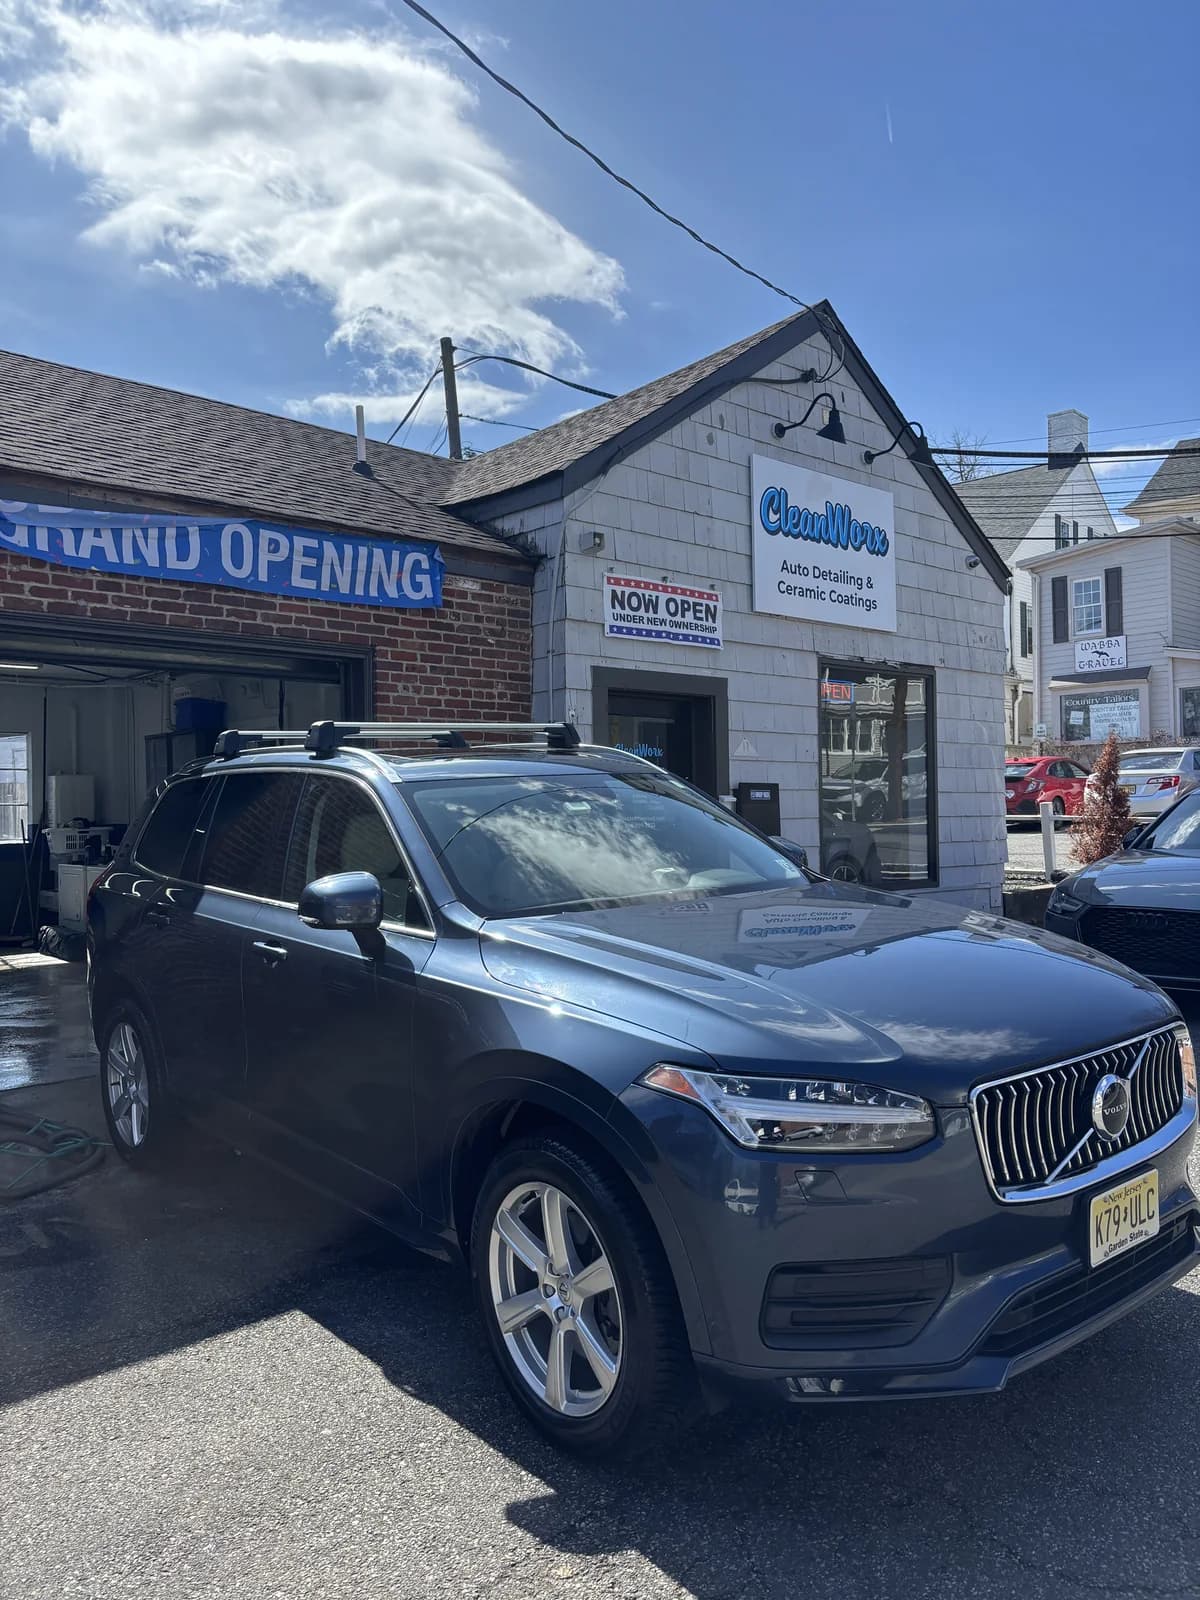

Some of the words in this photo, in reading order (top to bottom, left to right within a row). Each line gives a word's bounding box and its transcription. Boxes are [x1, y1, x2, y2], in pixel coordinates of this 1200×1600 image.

[760, 486, 889, 557] CleanWorx
[220, 523, 433, 600] OPENING
[780, 559, 810, 577] Auto
[812, 565, 863, 590] Detailing
[866, 576, 874, 590] &
[610, 589, 659, 615] NOW
[665, 597, 718, 624] OPEN
[777, 580, 827, 601] Ceramic
[829, 589, 878, 612] Coatings
[612, 612, 645, 625] UNDER
[646, 616, 667, 627] NEW
[668, 619, 717, 634] OWNERSHIP
[1080, 639, 1121, 652] WABBA
[1066, 698, 1100, 707] Country
[1103, 694, 1134, 703] Tailors
[1104, 1102, 1127, 1115] VOLV
[1108, 1191, 1122, 1205] New
[1123, 1182, 1143, 1200] Jersey
[1108, 1238, 1128, 1253] Garden
[1129, 1229, 1143, 1241] State
